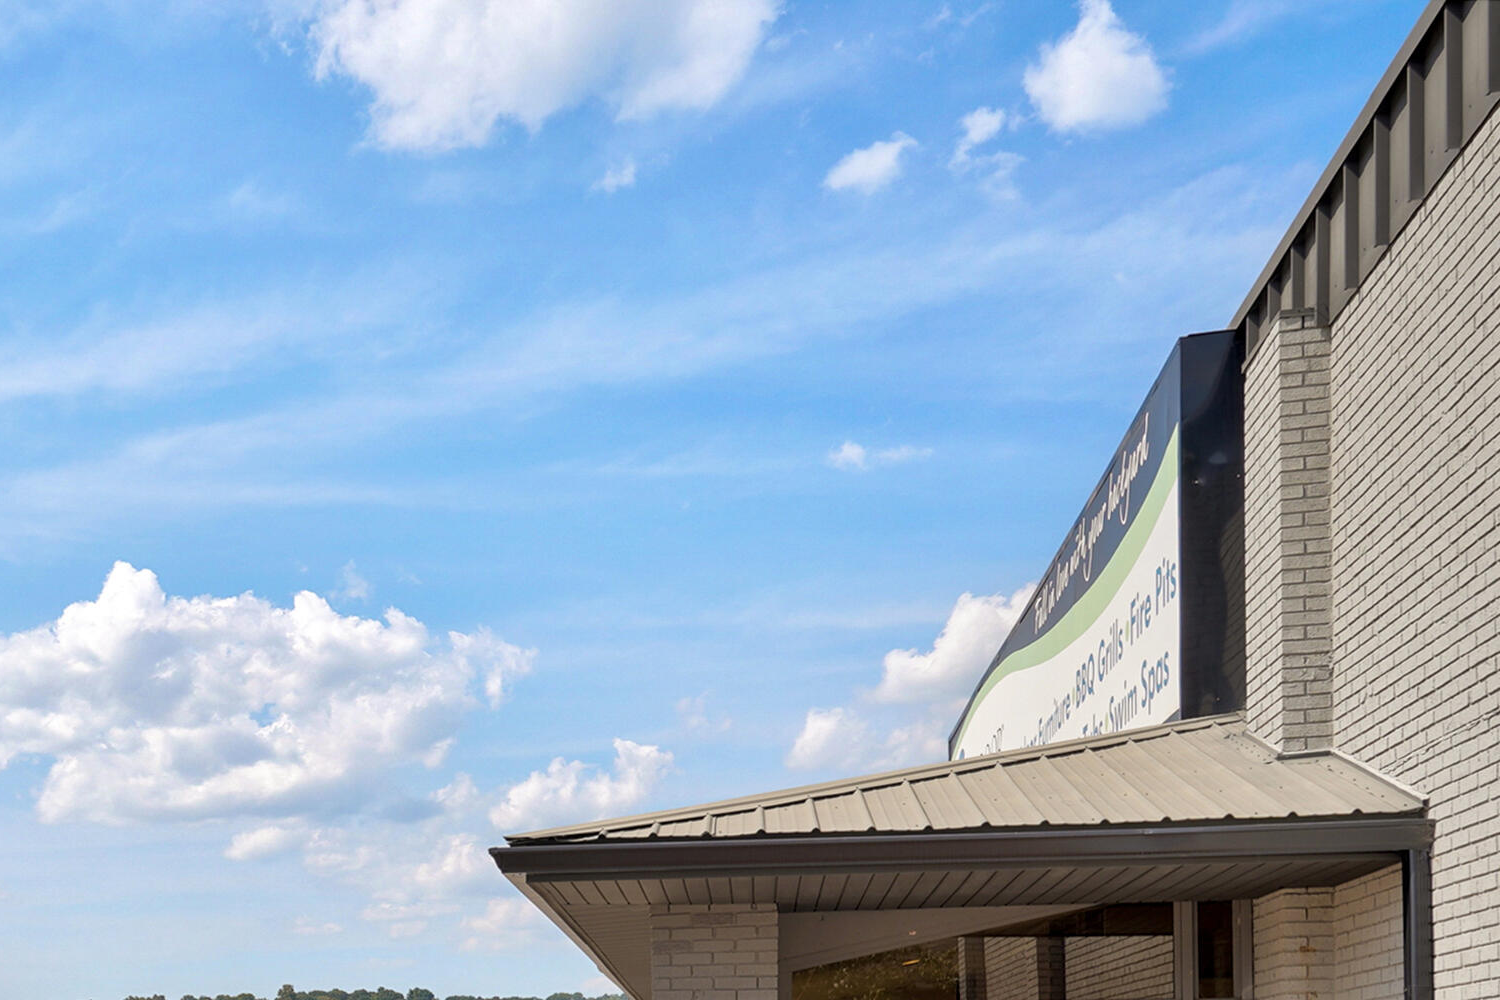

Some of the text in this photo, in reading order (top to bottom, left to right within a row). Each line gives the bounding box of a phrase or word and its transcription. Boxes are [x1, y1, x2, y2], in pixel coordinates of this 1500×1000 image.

[1034, 412, 1149, 635] Fall in love with your backyard
[1075, 653, 1095, 709] BBQ
[1098, 618, 1123, 682] Grills
[1130, 592, 1151, 646] Fire
[1155, 557, 1177, 616] Pits
[1109, 680, 1137, 734] Swim
[1141, 651, 1169, 715] Spas
